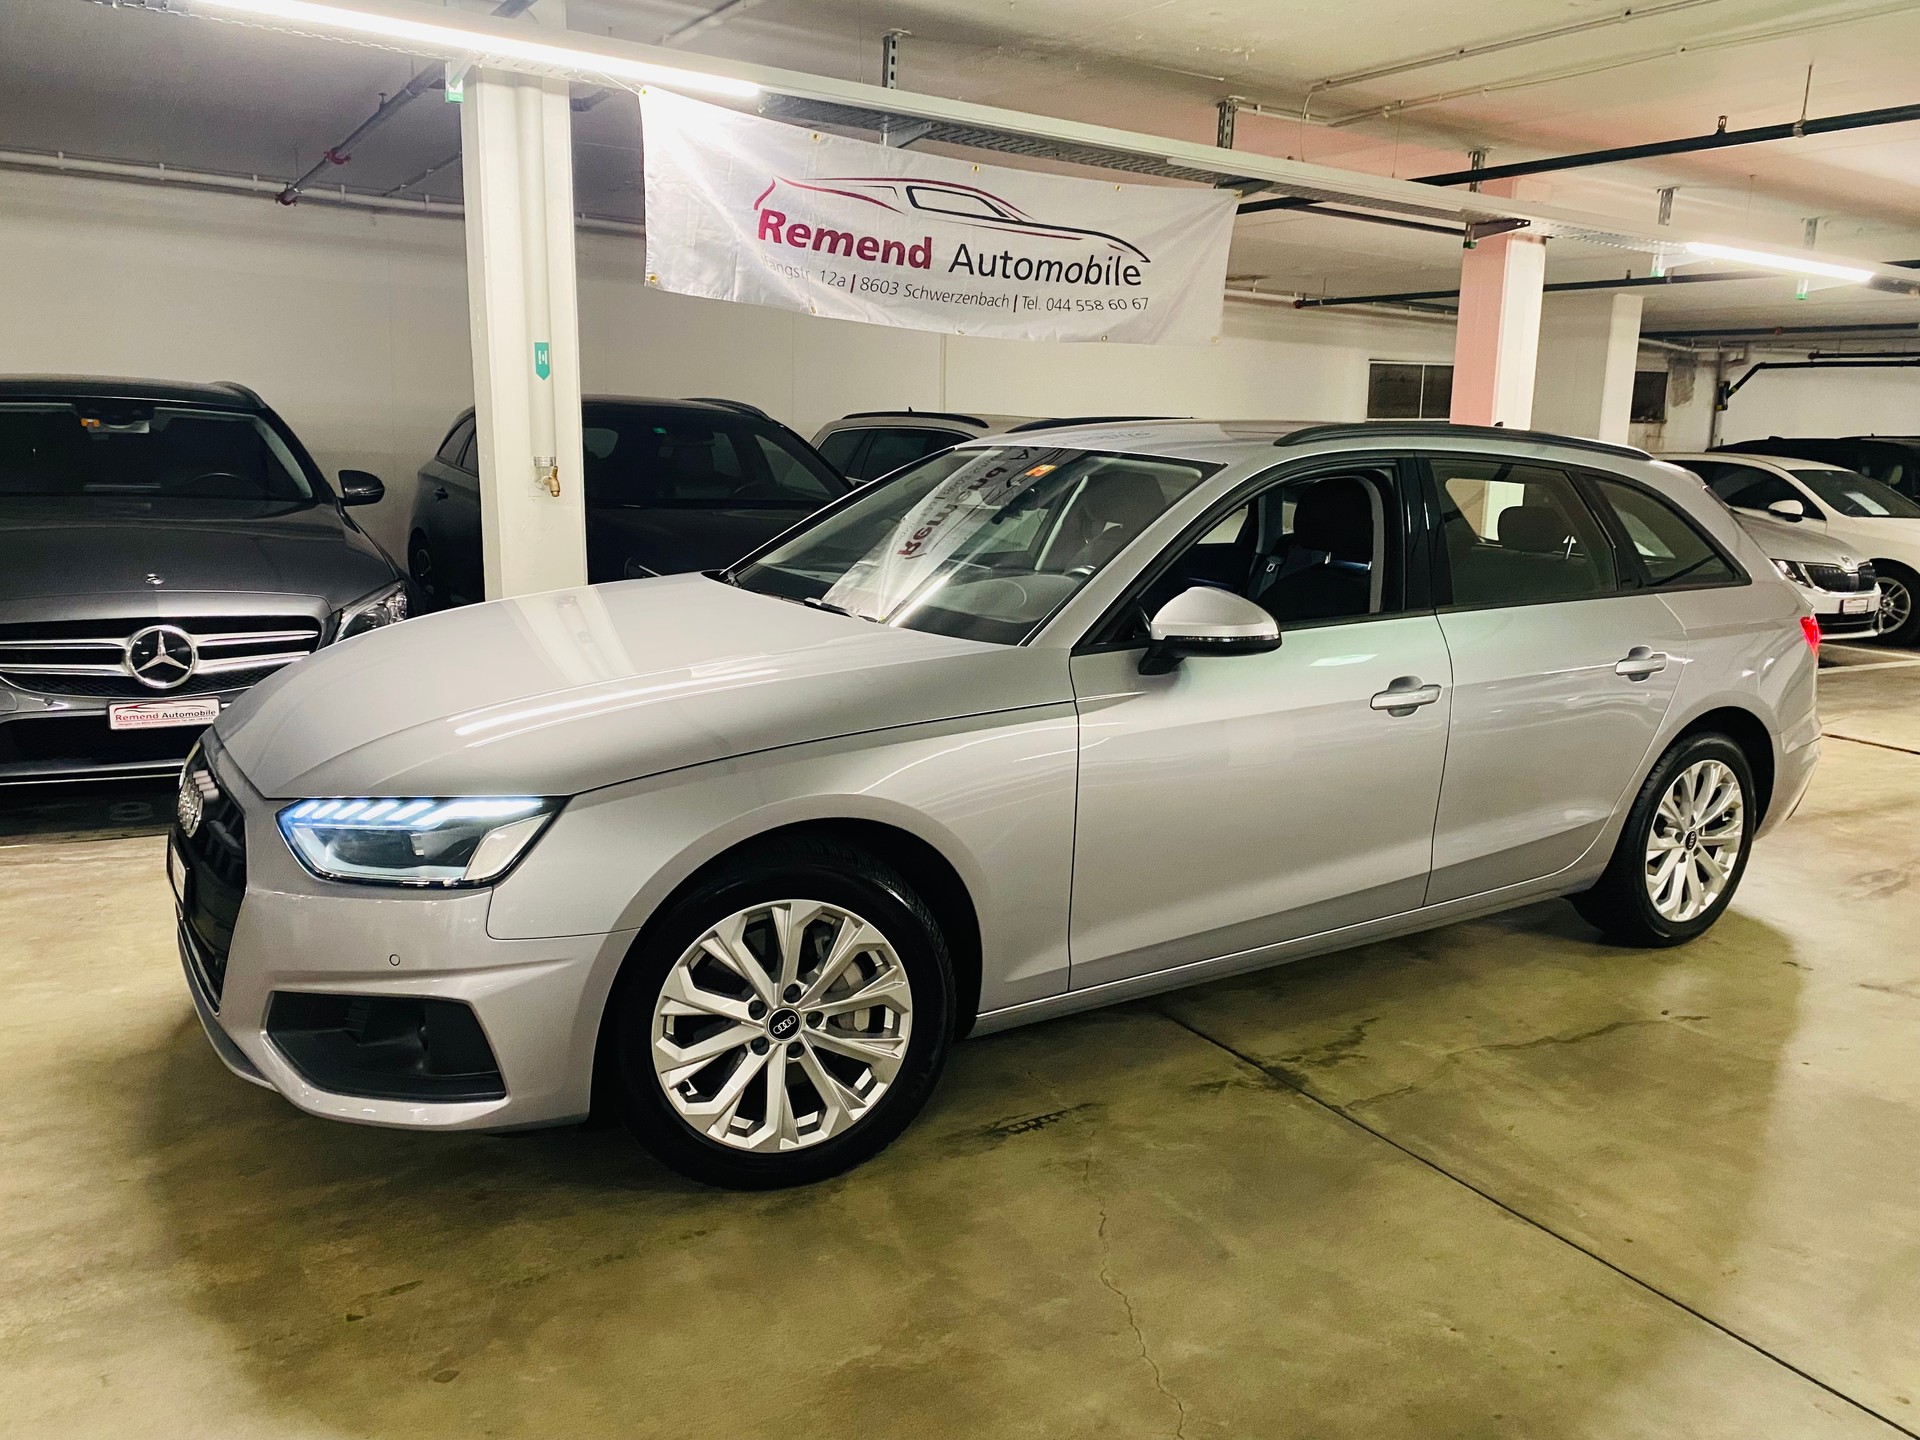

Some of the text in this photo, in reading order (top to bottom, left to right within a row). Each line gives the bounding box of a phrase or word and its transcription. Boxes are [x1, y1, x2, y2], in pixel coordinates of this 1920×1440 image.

[758, 208, 1142, 286] Remend Automobile
[819, 269, 846, 287] 12a
[860, 276, 899, 295] 8603
[904, 283, 1009, 308] Schwerzenbach
[1022, 295, 1041, 310] Tel.
[1046, 297, 1071, 311] 044
[1077, 299, 1104, 312] 558
[1108, 298, 1127, 310] 60
[1132, 297, 1149, 310] 67
[115, 709, 216, 721] Remend Automobile
